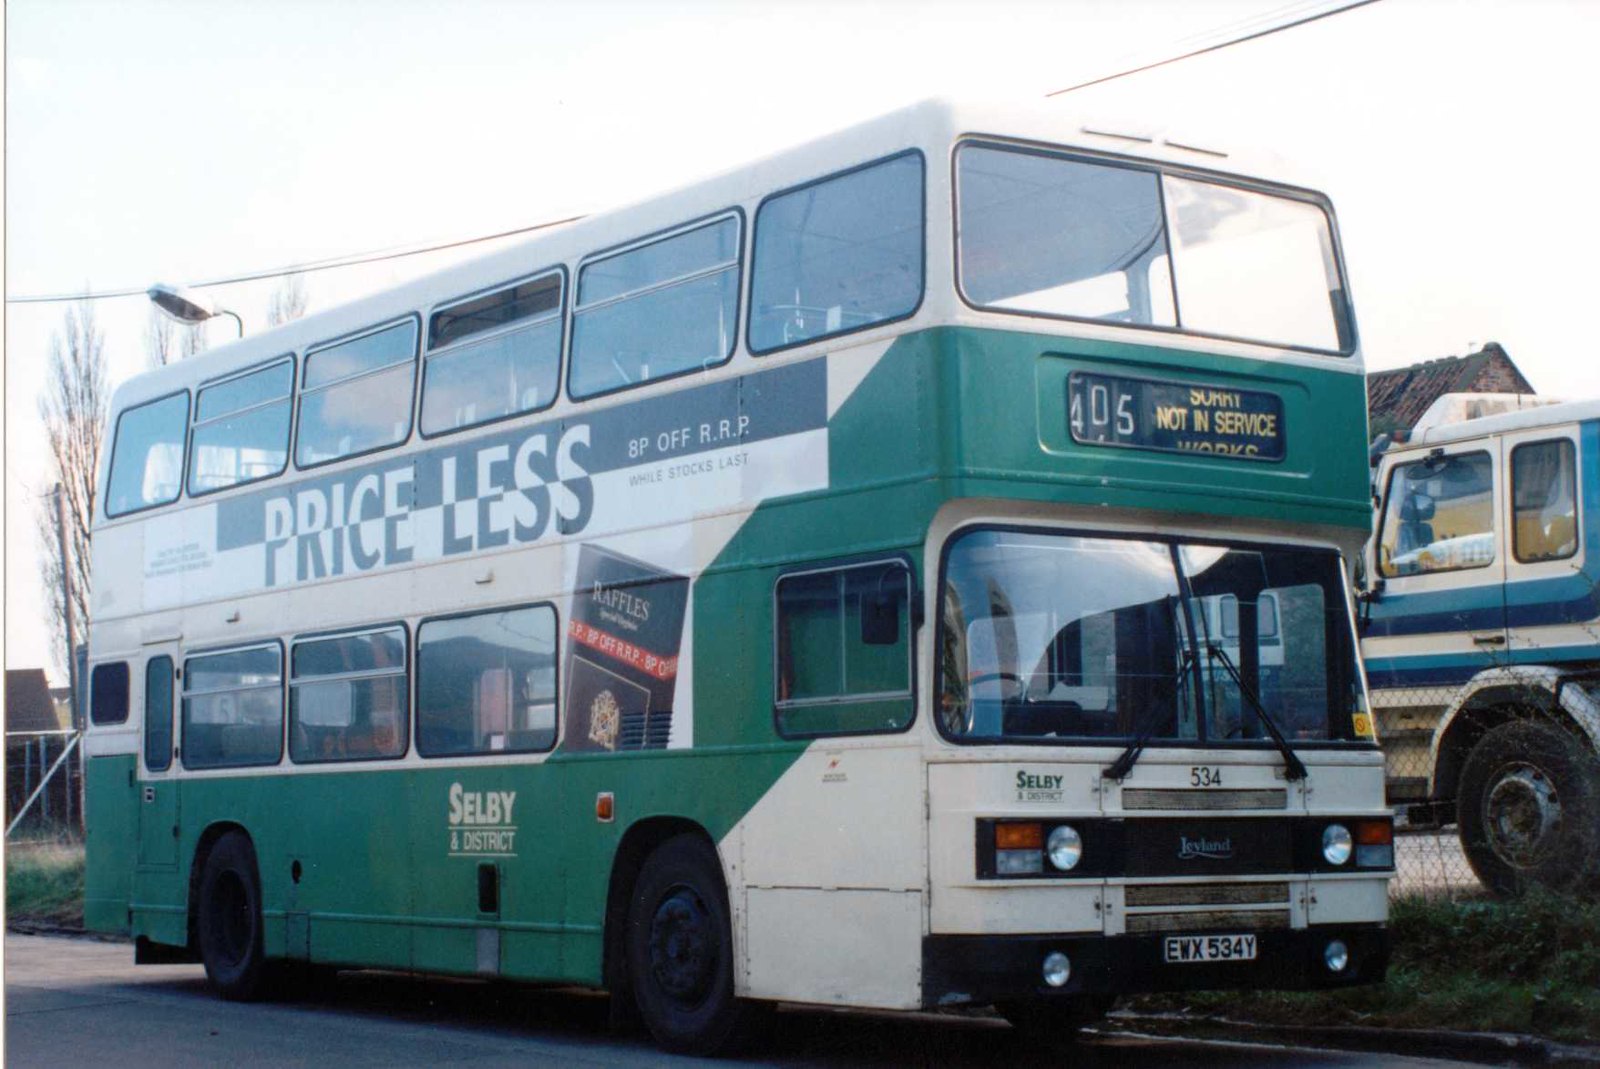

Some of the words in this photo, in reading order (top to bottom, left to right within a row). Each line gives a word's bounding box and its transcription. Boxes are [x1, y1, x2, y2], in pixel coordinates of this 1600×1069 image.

[1071, 385, 1134, 435] 405
[1156, 405, 1187, 431] NOT
[1193, 409, 1209, 433] IN
[1214, 410, 1277, 437] SERVICE
[628, 438, 649, 459] 8P
[657, 427, 691, 452] OFF
[700, 415, 750, 444] R.R.P.
[629, 469, 663, 487] WHILE
[667, 459, 714, 480] STOCKS
[719, 452, 750, 470] LAST
[265, 466, 414, 587] PRICE
[442, 424, 594, 556] LESS
[1191, 767, 1222, 787] 534
[1027, 791, 1063, 801] DISTRICT
[450, 831, 459, 850] &
[463, 831, 516, 850] DISTRICT
[1179, 836, 1232, 857] Leyland
[1167, 938, 1204, 960] EWX
[1208, 935, 1255, 958] 534Y
